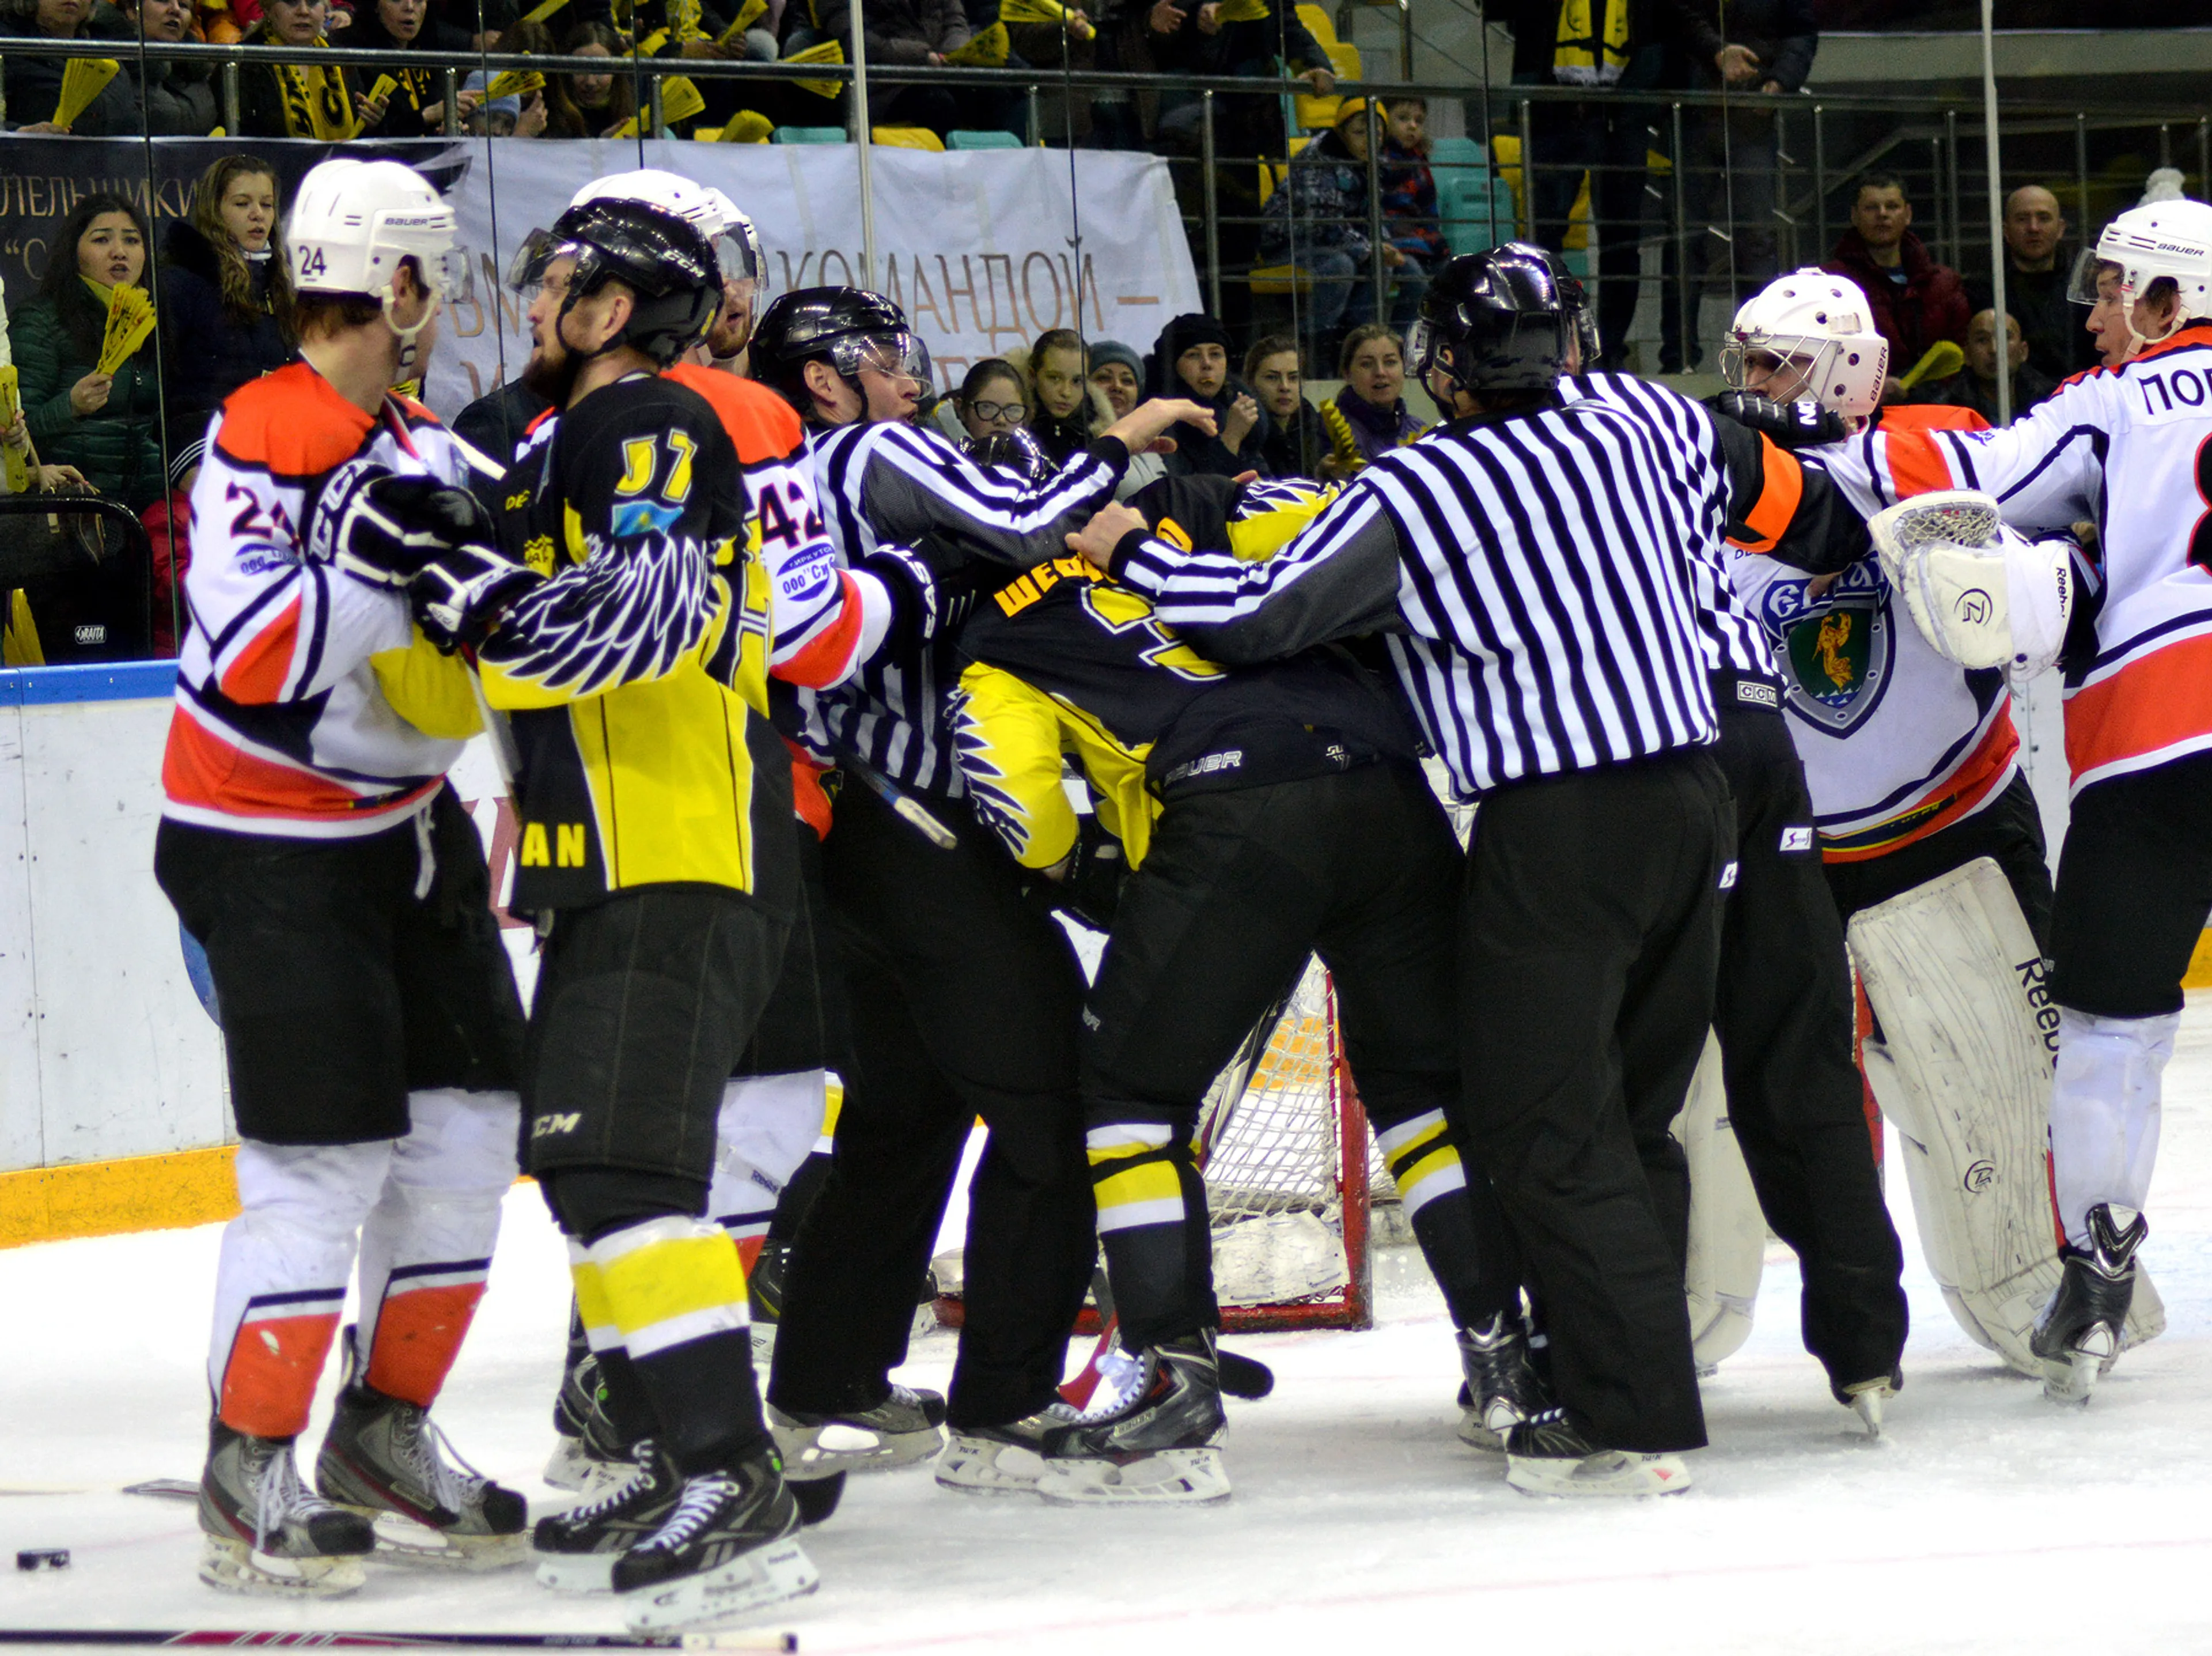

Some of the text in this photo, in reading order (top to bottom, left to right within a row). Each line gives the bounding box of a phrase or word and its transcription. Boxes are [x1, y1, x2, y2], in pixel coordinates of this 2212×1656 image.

[384, 217, 429, 226] BAUER
[298, 245, 327, 276] 24
[663, 249, 706, 278] CCM
[2157, 243, 2205, 256] BAUER
[1870, 346, 1887, 402] BAUER
[2137, 368, 2212, 415] ПО
[2014, 956, 2061, 1071] Reeb
